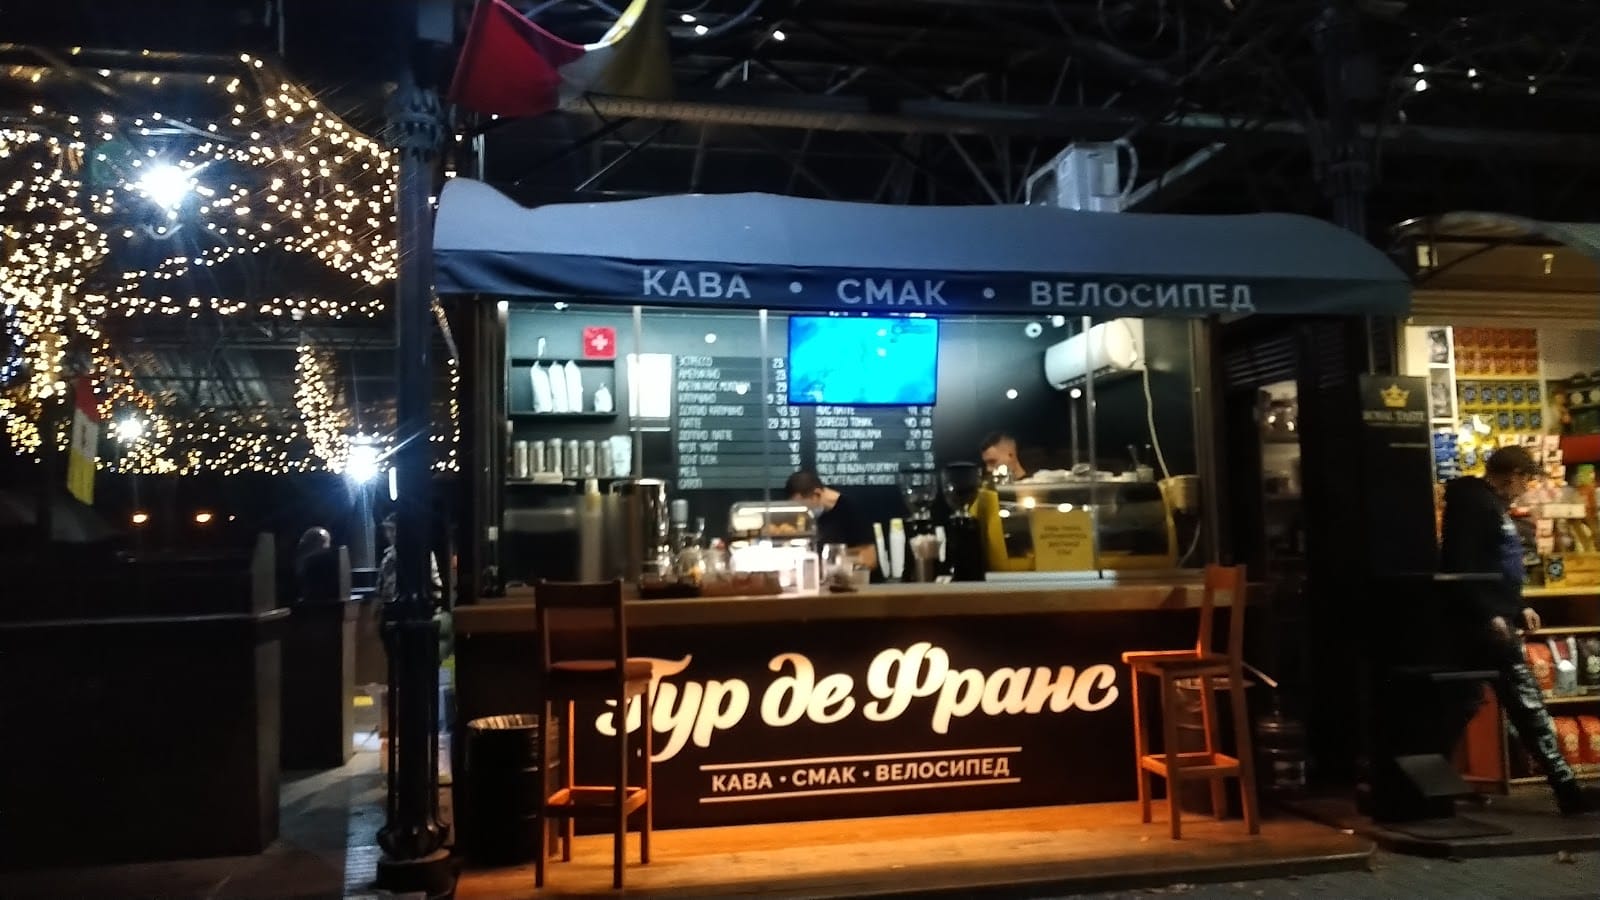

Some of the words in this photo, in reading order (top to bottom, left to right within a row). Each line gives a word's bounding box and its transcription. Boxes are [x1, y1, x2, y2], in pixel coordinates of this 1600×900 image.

[642, 268, 752, 299] КАВА
[836, 278, 948, 306] СМАК
[1030, 280, 1256, 313] ВЕЛОСИПЕД
[760, 652, 857, 728] де
[863, 642, 1119, 735] Франс
[711, 773, 773, 793] КАВА
[791, 766, 857, 787] СМАК
[875, 757, 1011, 783] ВЕЛОСИПЕД
